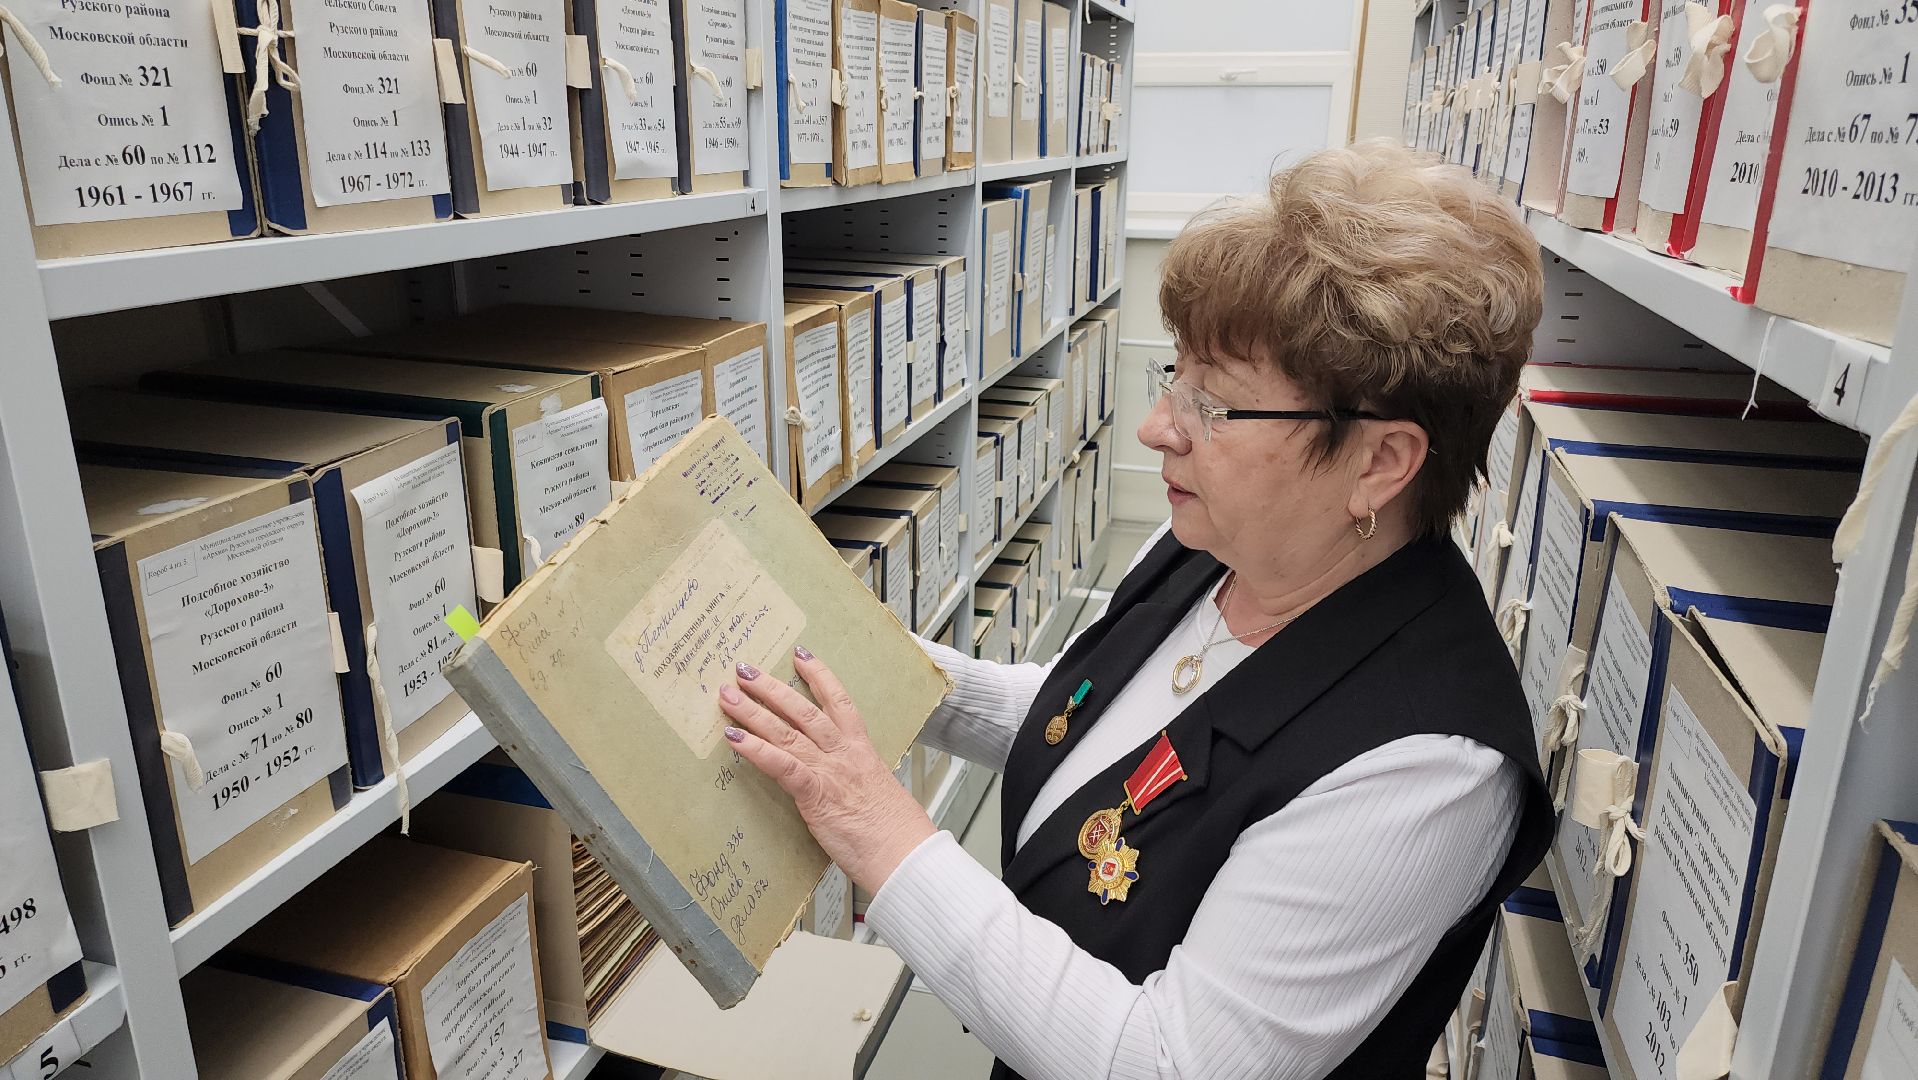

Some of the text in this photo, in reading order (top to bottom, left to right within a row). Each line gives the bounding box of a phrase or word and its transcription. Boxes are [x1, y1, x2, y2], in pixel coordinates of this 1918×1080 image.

[61, 0, 171, 19] Рузского района
[1849, 8, 1890, 31] Фонд №
[48, 26, 189, 48] Московской области
[328, 21, 399, 38] Рузского района
[322, 46, 410, 62] Московской области
[80, 65, 174, 87] Фонд № 321
[525, 61, 538, 78] 60
[645, 71, 654, 86] 60
[1845, 51, 1911, 87] Опись № 1
[342, 76, 400, 95] Фонд № 321
[725, 76, 733, 88] 60
[532, 89, 538, 105] 1
[97, 105, 171, 127] Опись № 1
[352, 109, 399, 128] Опись № 1
[521, 116, 553, 131] 1 32
[638, 117, 666, 132] 33 54
[719, 116, 727, 129] 55
[1597, 118, 1610, 135] 53
[1669, 118, 1680, 138] 59
[1804, 112, 1900, 144] Дела с № 67 по №
[1735, 129, 1755, 145] Дела
[58, 143, 218, 170] Дела с № 60 по № 112
[325, 139, 431, 163] Дела № 114 по № 133
[499, 142, 548, 159] 1944 1947
[340, 171, 415, 194] 1967 1972
[1729, 161, 1760, 185] 2010
[1801, 166, 1900, 203] 2010 2013
[75, 181, 216, 208] 1961 1967 гг.
[750, 197, 756, 212] 4
[1832, 362, 1851, 407] 4
[573, 511, 586, 528] 89
[261, 536, 285, 549] области
[393, 527, 447, 562] Рузского района
[147, 564, 169, 580] Короб
[180, 556, 291, 609] Подсобное хозяйство
[387, 554, 431, 587] Московской
[433, 576, 446, 595] 60
[203, 581, 275, 619] «Дорохово-3»
[199, 601, 286, 646] Рузского района
[412, 602, 448, 637] Опись № 1
[653, 612, 707, 680] ПОХОЗЯЙСТВЕННАЯ
[705, 590, 727, 616] КНИГА
[190, 619, 299, 677] Московской области
[397, 659, 416, 676] Дела
[419, 649, 427, 660] №
[426, 635, 440, 655] 81
[220, 660, 284, 705] Фонд № 60
[402, 669, 429, 698] 1953
[227, 691, 285, 736] Опись № 1
[204, 706, 314, 786] Дела № 71 по № 80
[211, 744, 316, 812] 1950 1952 гг.
[1667, 761, 1711, 836] Администрация
[689, 825, 745, 902] Фонд 336
[742, 859, 752, 875] 3
[1659, 803, 1685, 851] Рузского
[1683, 845, 1730, 937] муниципального
[1653, 823, 1728, 968] района Московской области
[13, 951, 32, 970] гг.
[1682, 942, 1700, 987] 350
[1655, 990, 1672, 1033] 103
[1681, 994, 1688, 1021] 1
[488, 1019, 507, 1048] 157
[511, 1046, 525, 1071] 27
[1645, 1020, 1666, 1077] 2012
[39, 1043, 60, 1080] 5
